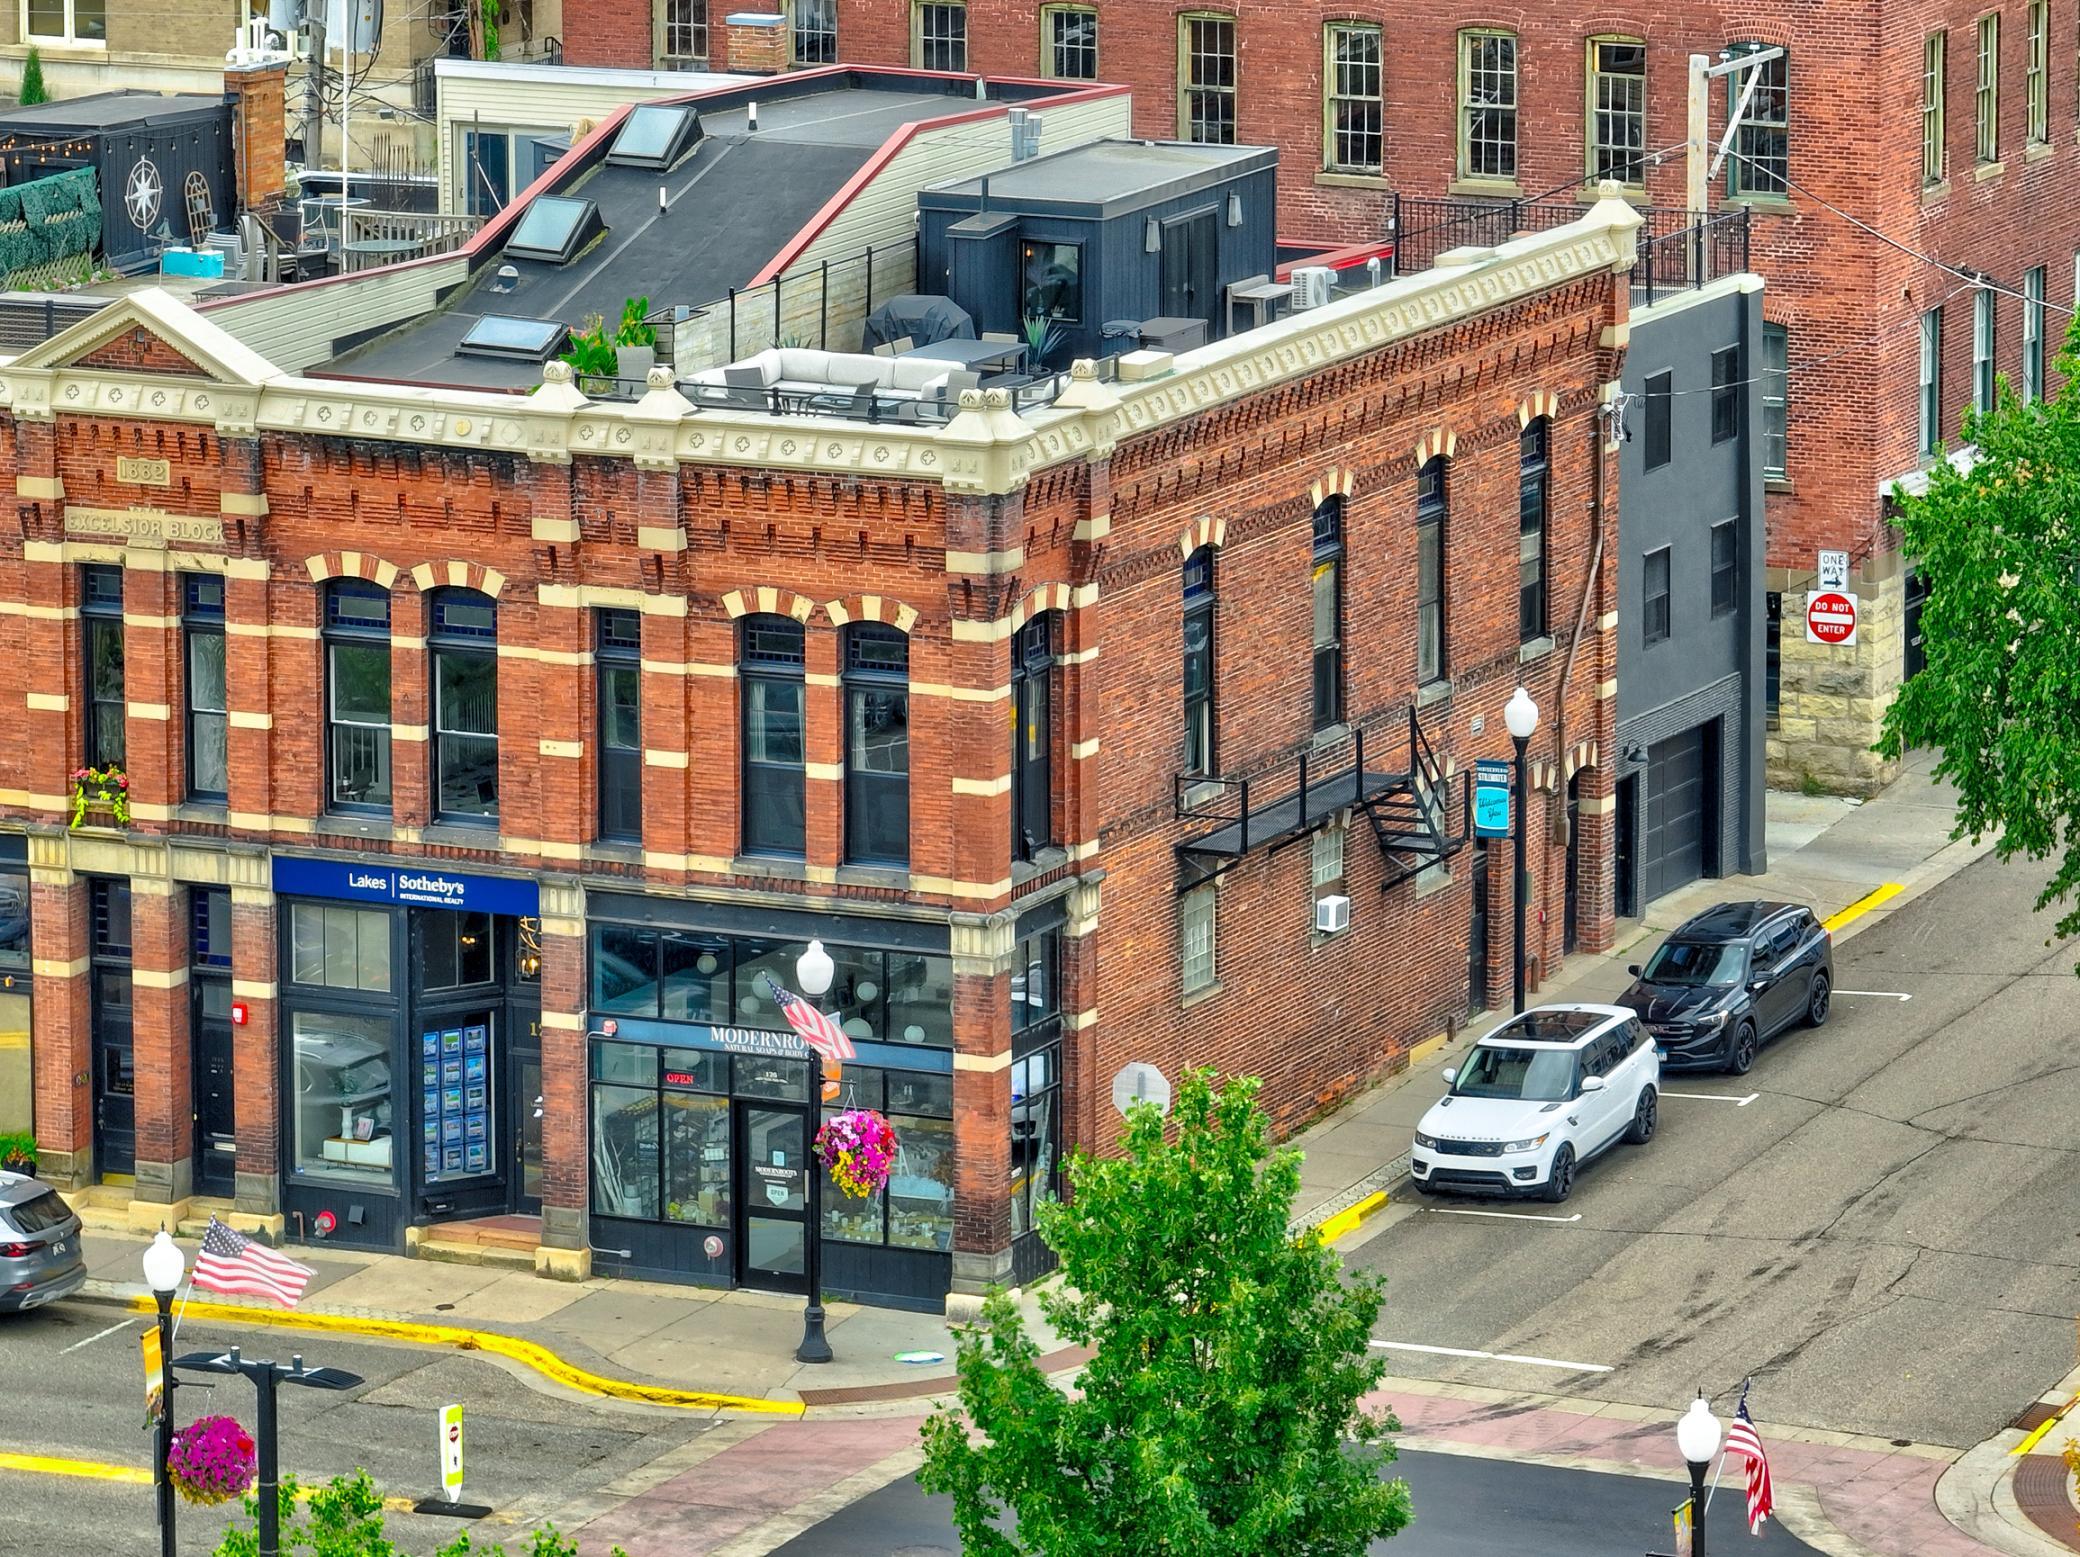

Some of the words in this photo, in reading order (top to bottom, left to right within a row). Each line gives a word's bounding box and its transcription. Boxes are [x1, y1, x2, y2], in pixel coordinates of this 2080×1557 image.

[120, 460, 165, 480] 1882
[68, 514, 162, 536] EXCELSIOR
[169, 521, 225, 541] BLOCK
[1823, 555, 1844, 566] ONE
[1823, 566, 1844, 576] WAY
[1815, 602, 1828, 611] DO
[1832, 603, 1850, 612] NOT
[1817, 624, 1845, 635] ENTER
[349, 872, 387, 890] Lakes
[399, 875, 465, 896] Sotheby's
[710, 1026, 809, 1051] MODERNRO
[724, 1043, 754, 1053] NATURAL
[756, 1047, 777, 1056] SOAPS
[785, 1049, 803, 1058] BODY
[666, 1072, 694, 1084] OPEN
